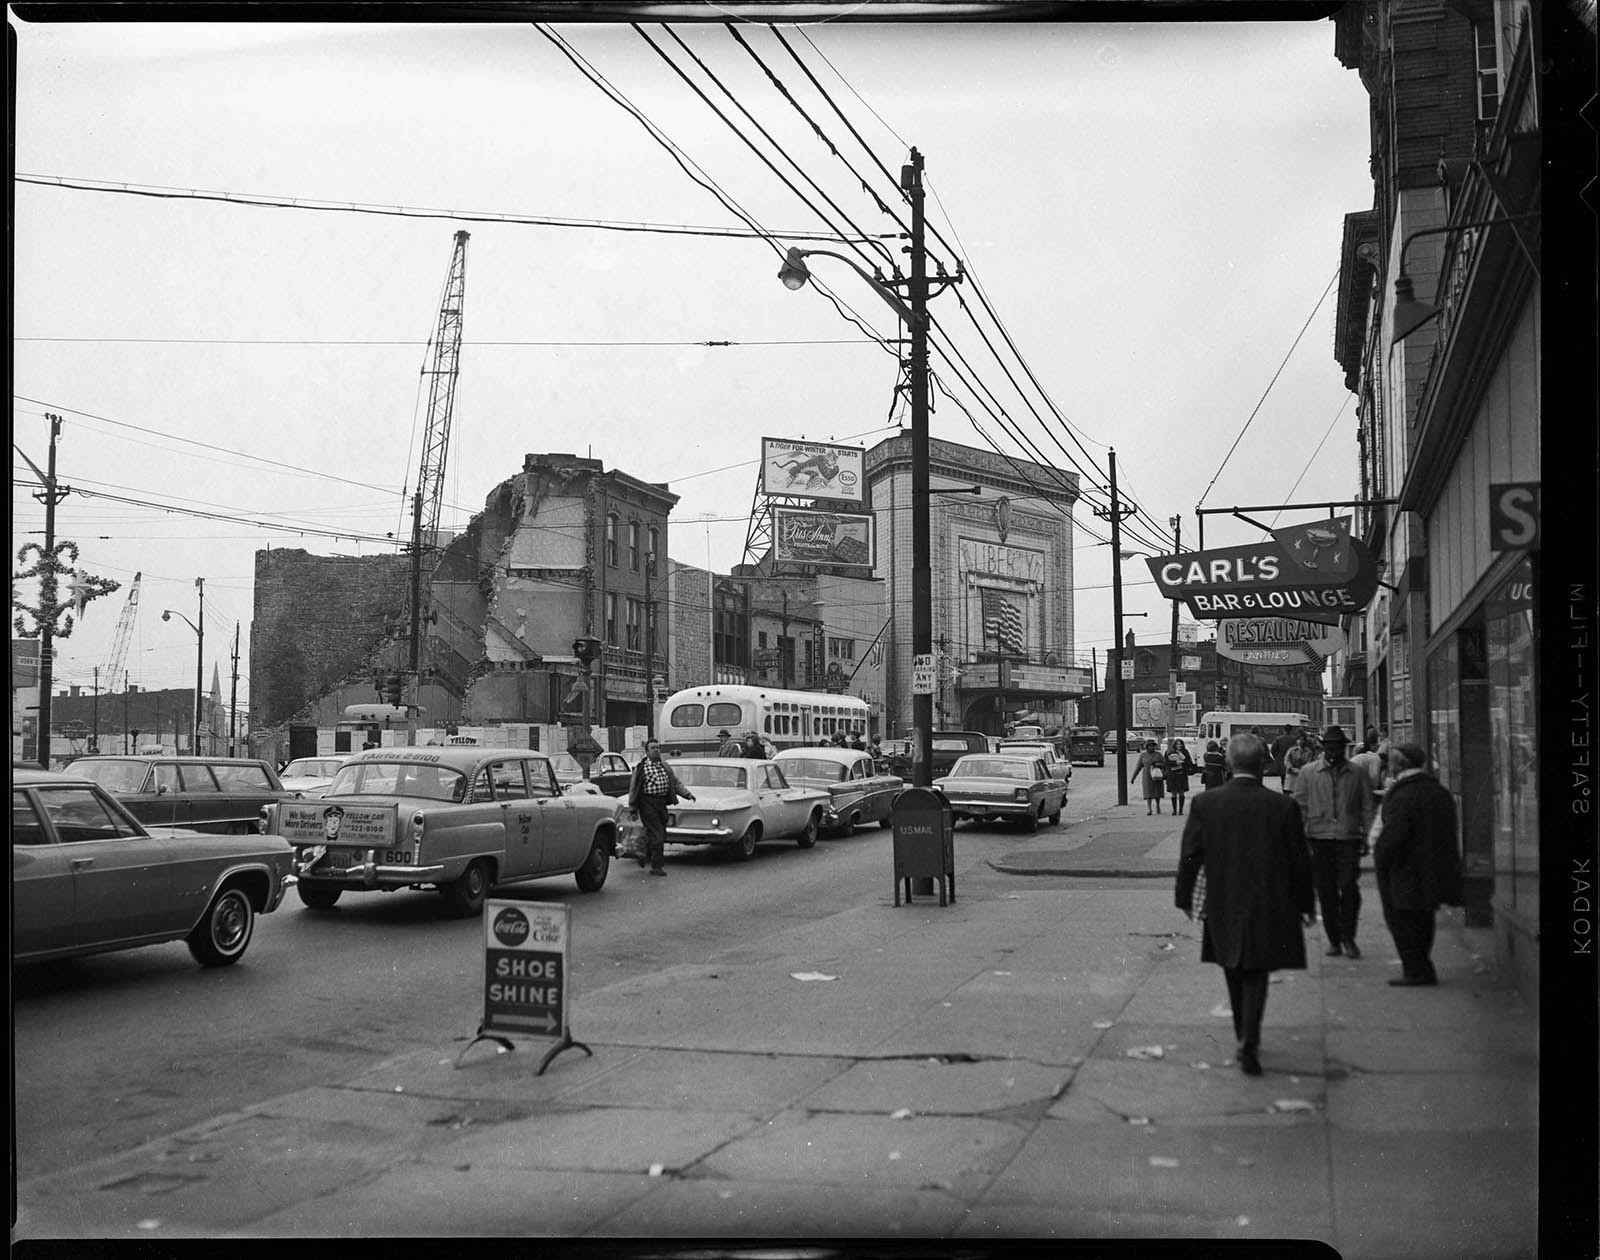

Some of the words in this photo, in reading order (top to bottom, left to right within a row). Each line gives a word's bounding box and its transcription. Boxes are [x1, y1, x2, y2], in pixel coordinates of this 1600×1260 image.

[804, 445, 826, 454] WINTER
[837, 449, 858, 458] STARTS
[1500, 488, 1537, 546] S
[1161, 556, 1280, 586] CARL'S
[1193, 594, 1242, 612] BAR
[1257, 588, 1356, 609] LOUNGE
[914, 656, 931, 666] NO
[914, 673, 932, 681] ANY
[450, 736, 478, 745] YELLOW
[289, 810, 299, 820] We
[300, 810, 317, 821] Need
[345, 812, 370, 820] YELLOW
[371, 813, 385, 821] CAB
[285, 819, 300, 829] More
[300, 820, 323, 830] Drivers
[385, 850, 412, 863] 600
[495, 957, 557, 979] SHOE
[488, 983, 559, 1005] SHINE
